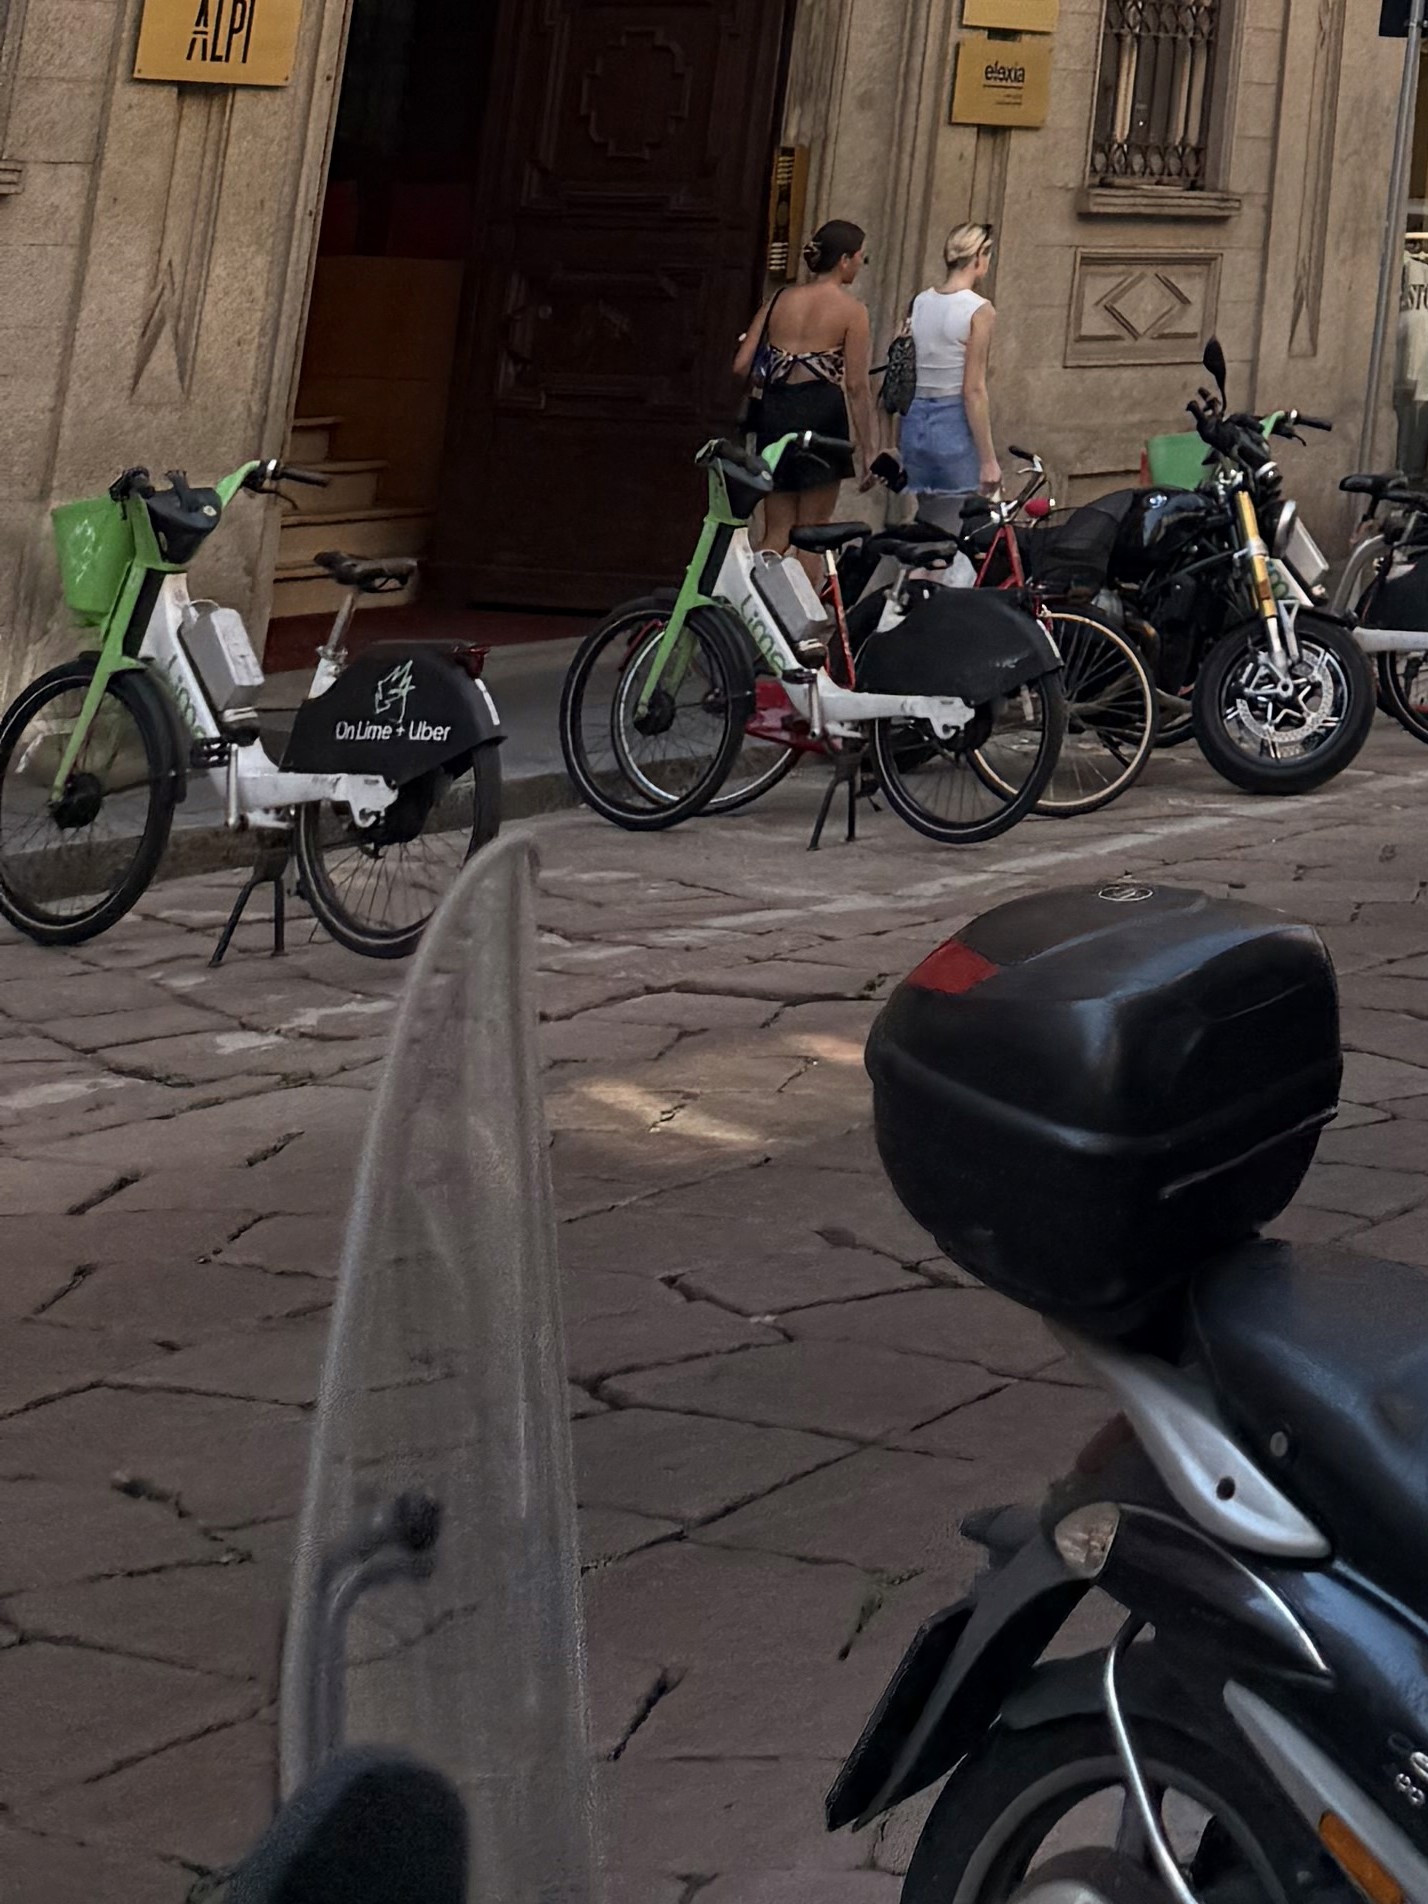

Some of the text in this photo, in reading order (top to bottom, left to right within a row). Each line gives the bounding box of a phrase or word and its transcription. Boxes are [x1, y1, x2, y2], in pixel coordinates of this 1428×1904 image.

[335, 721, 355, 740] On
[356, 721, 393, 741] Lime
[408, 720, 451, 741] Uber
